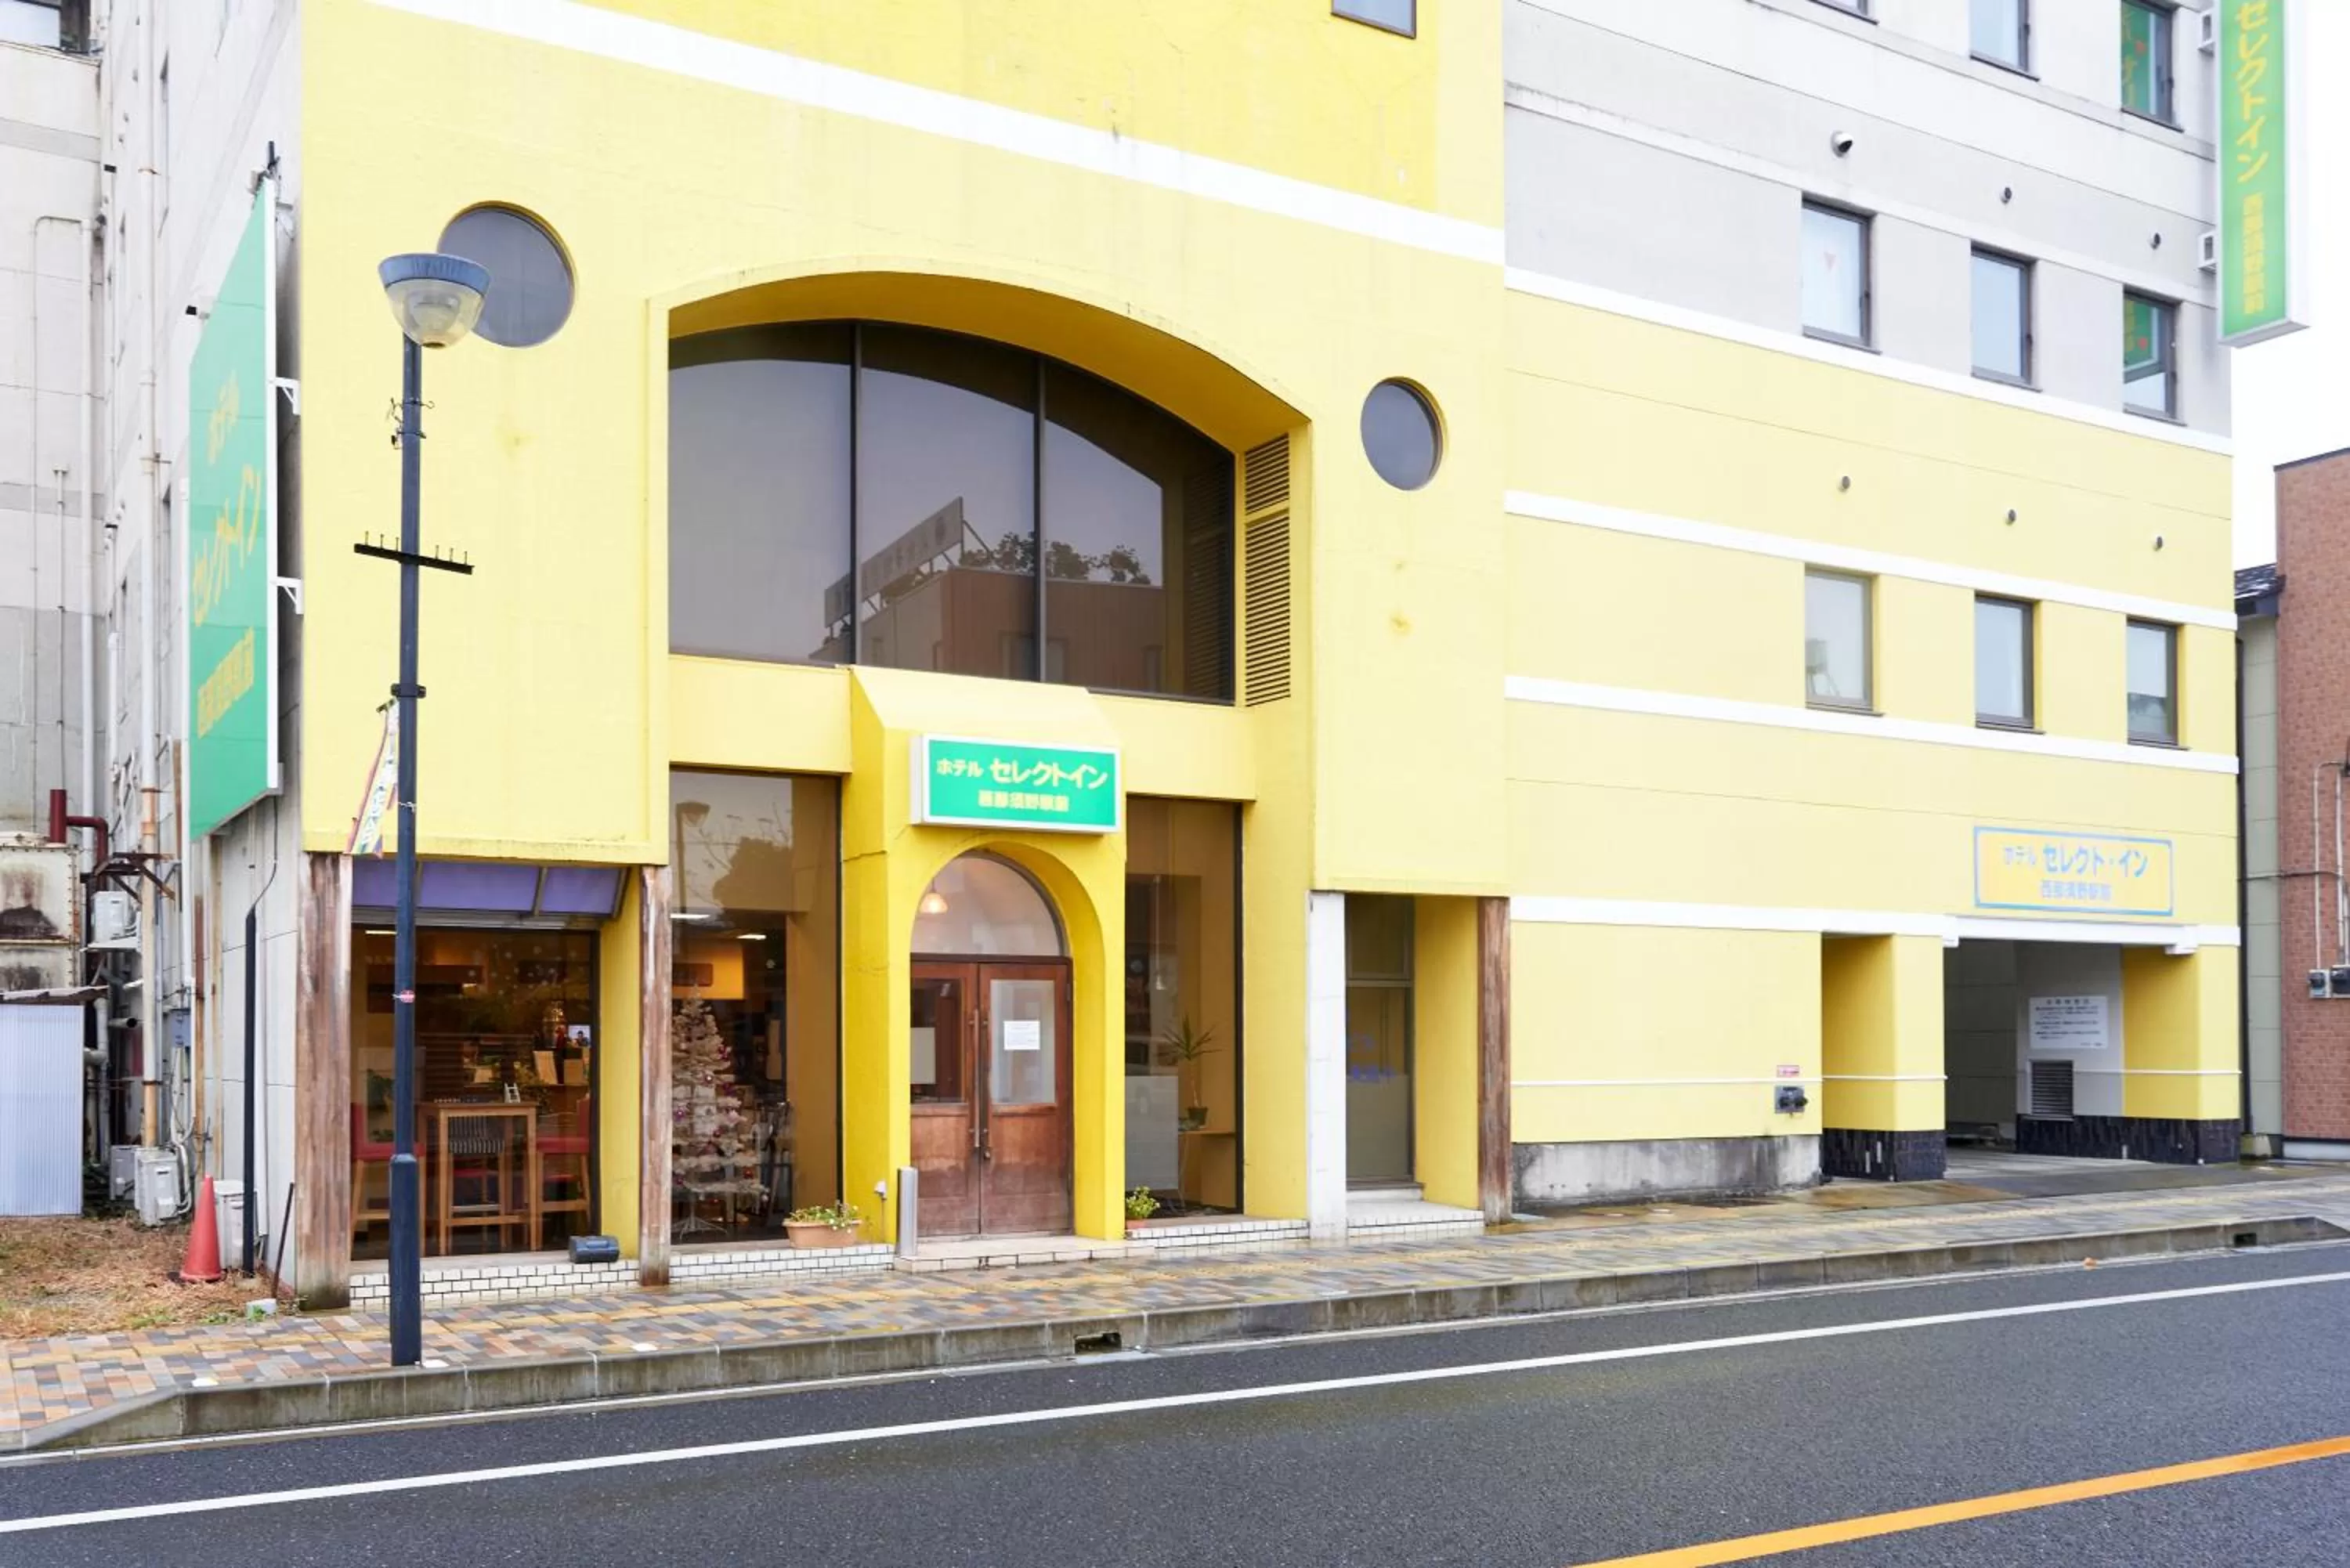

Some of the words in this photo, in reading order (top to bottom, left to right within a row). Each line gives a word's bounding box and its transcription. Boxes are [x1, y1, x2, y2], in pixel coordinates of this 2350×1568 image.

[2234, 1, 2269, 182] セレクトイン
[936, 757, 984, 778] ホテル
[989, 757, 1108, 789] セレクトイン
